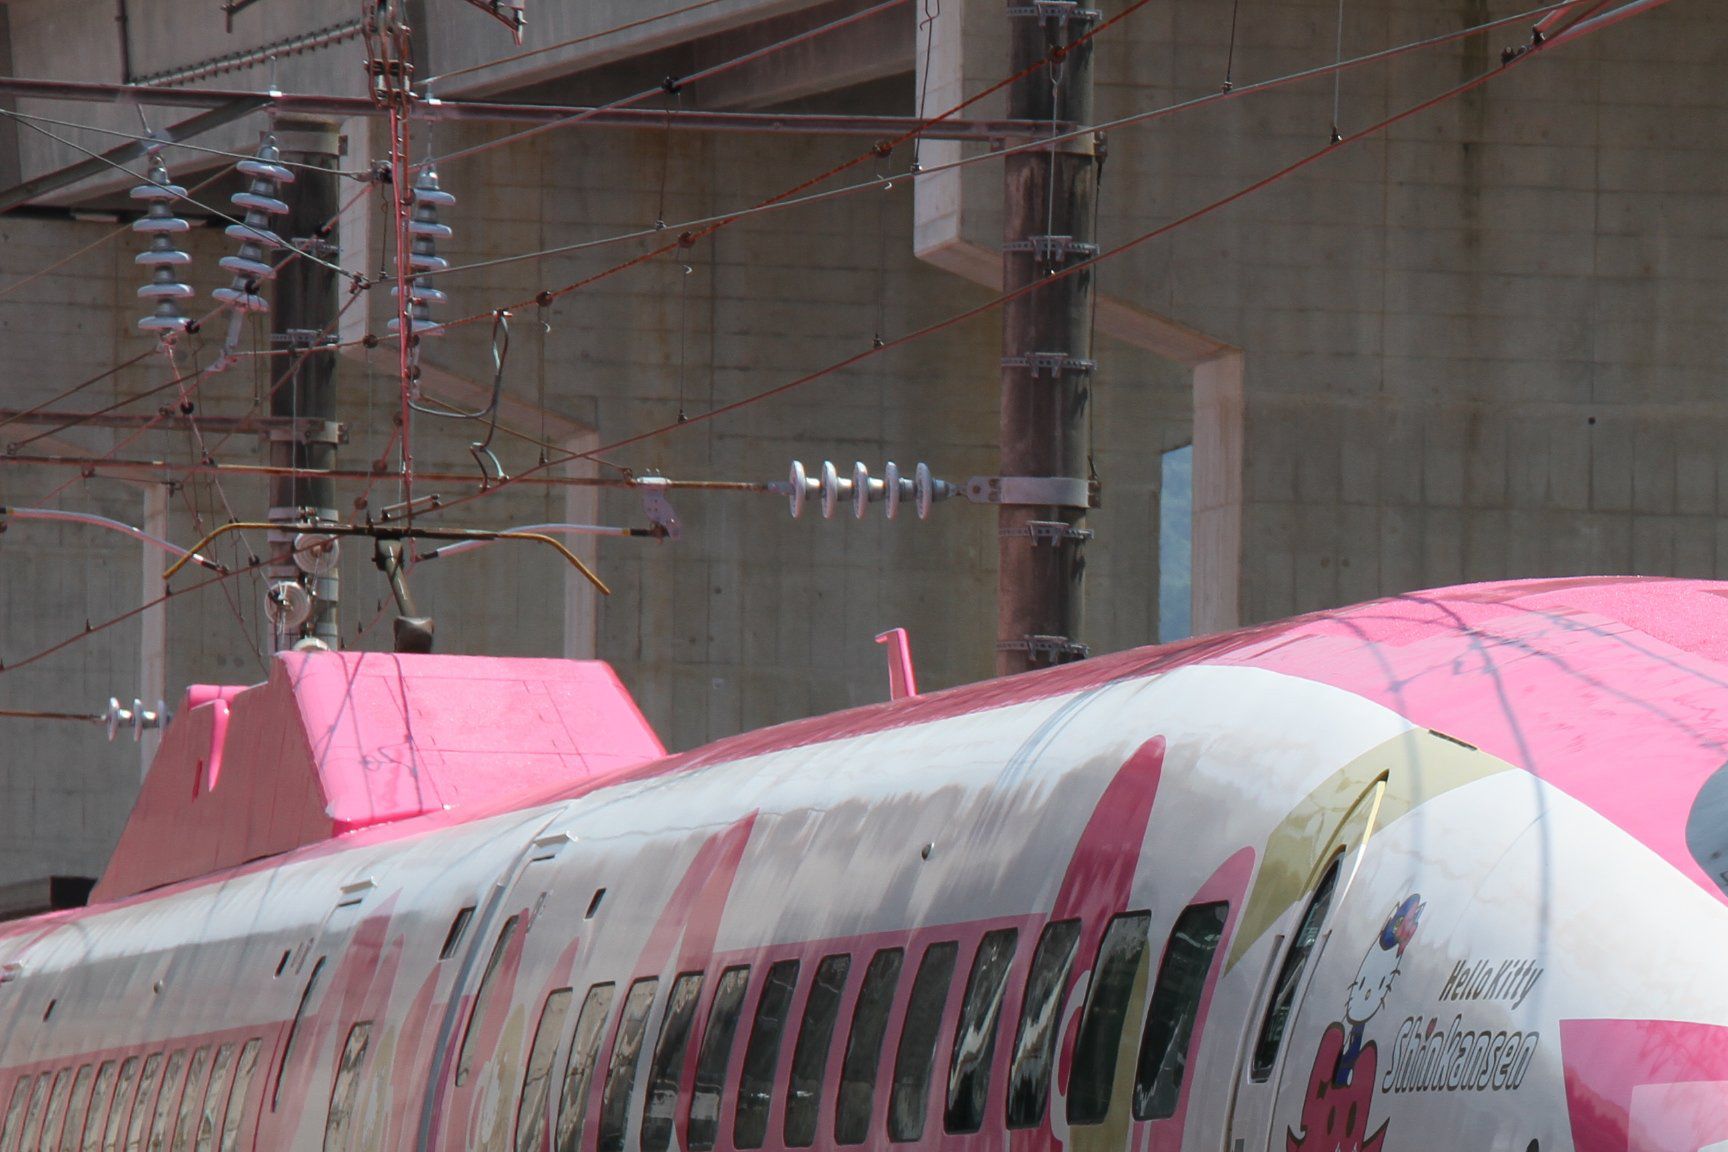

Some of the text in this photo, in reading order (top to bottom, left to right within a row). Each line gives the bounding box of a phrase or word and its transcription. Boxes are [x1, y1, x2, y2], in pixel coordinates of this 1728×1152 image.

[1438, 959, 1544, 1010] Hello Kitty
[1381, 1013, 1540, 1094] Shinkansen
